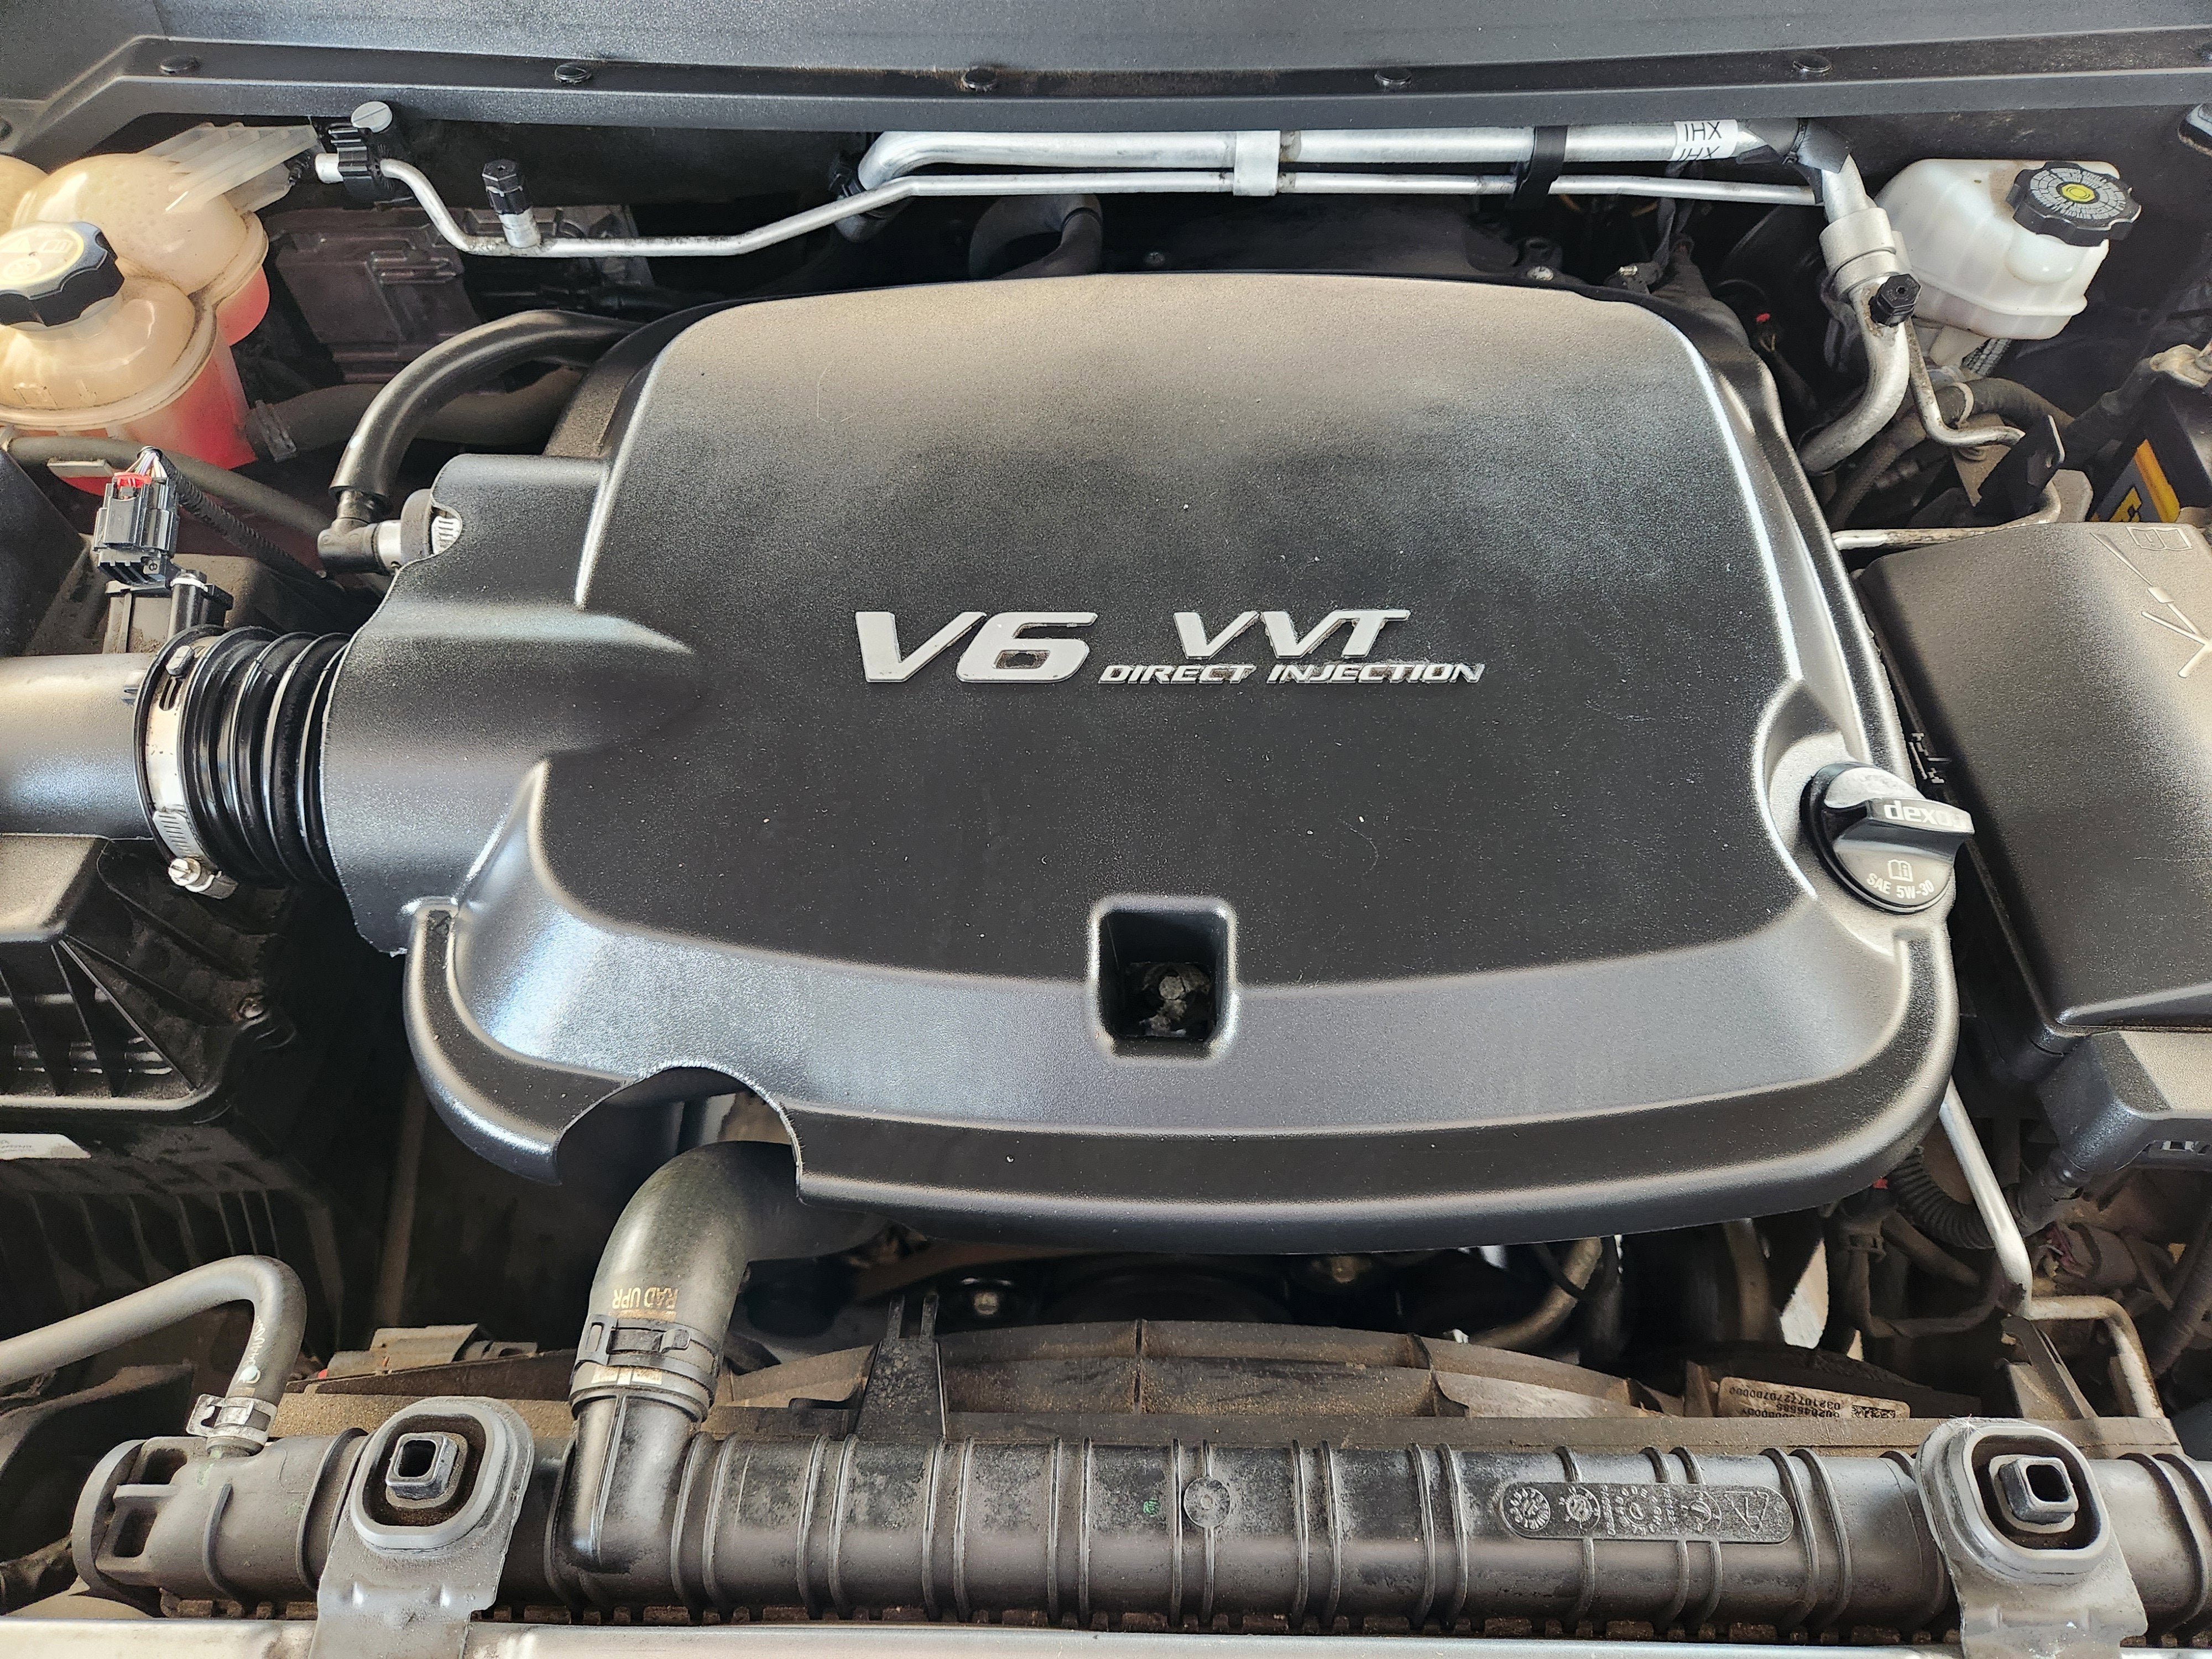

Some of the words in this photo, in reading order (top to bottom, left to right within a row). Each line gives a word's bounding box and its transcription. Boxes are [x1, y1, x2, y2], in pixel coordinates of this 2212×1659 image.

[1173, 609, 1411, 660] VVT
[855, 611, 1098, 683] V6
[1098, 664, 1256, 684] DIRECT
[1266, 662, 1486, 684] INJECTION
[1866, 873, 1892, 895] SAE
[1896, 879, 1934, 899] 5W-30
[612, 1287, 641, 1309] UPR
[644, 1287, 679, 1310] RAD
